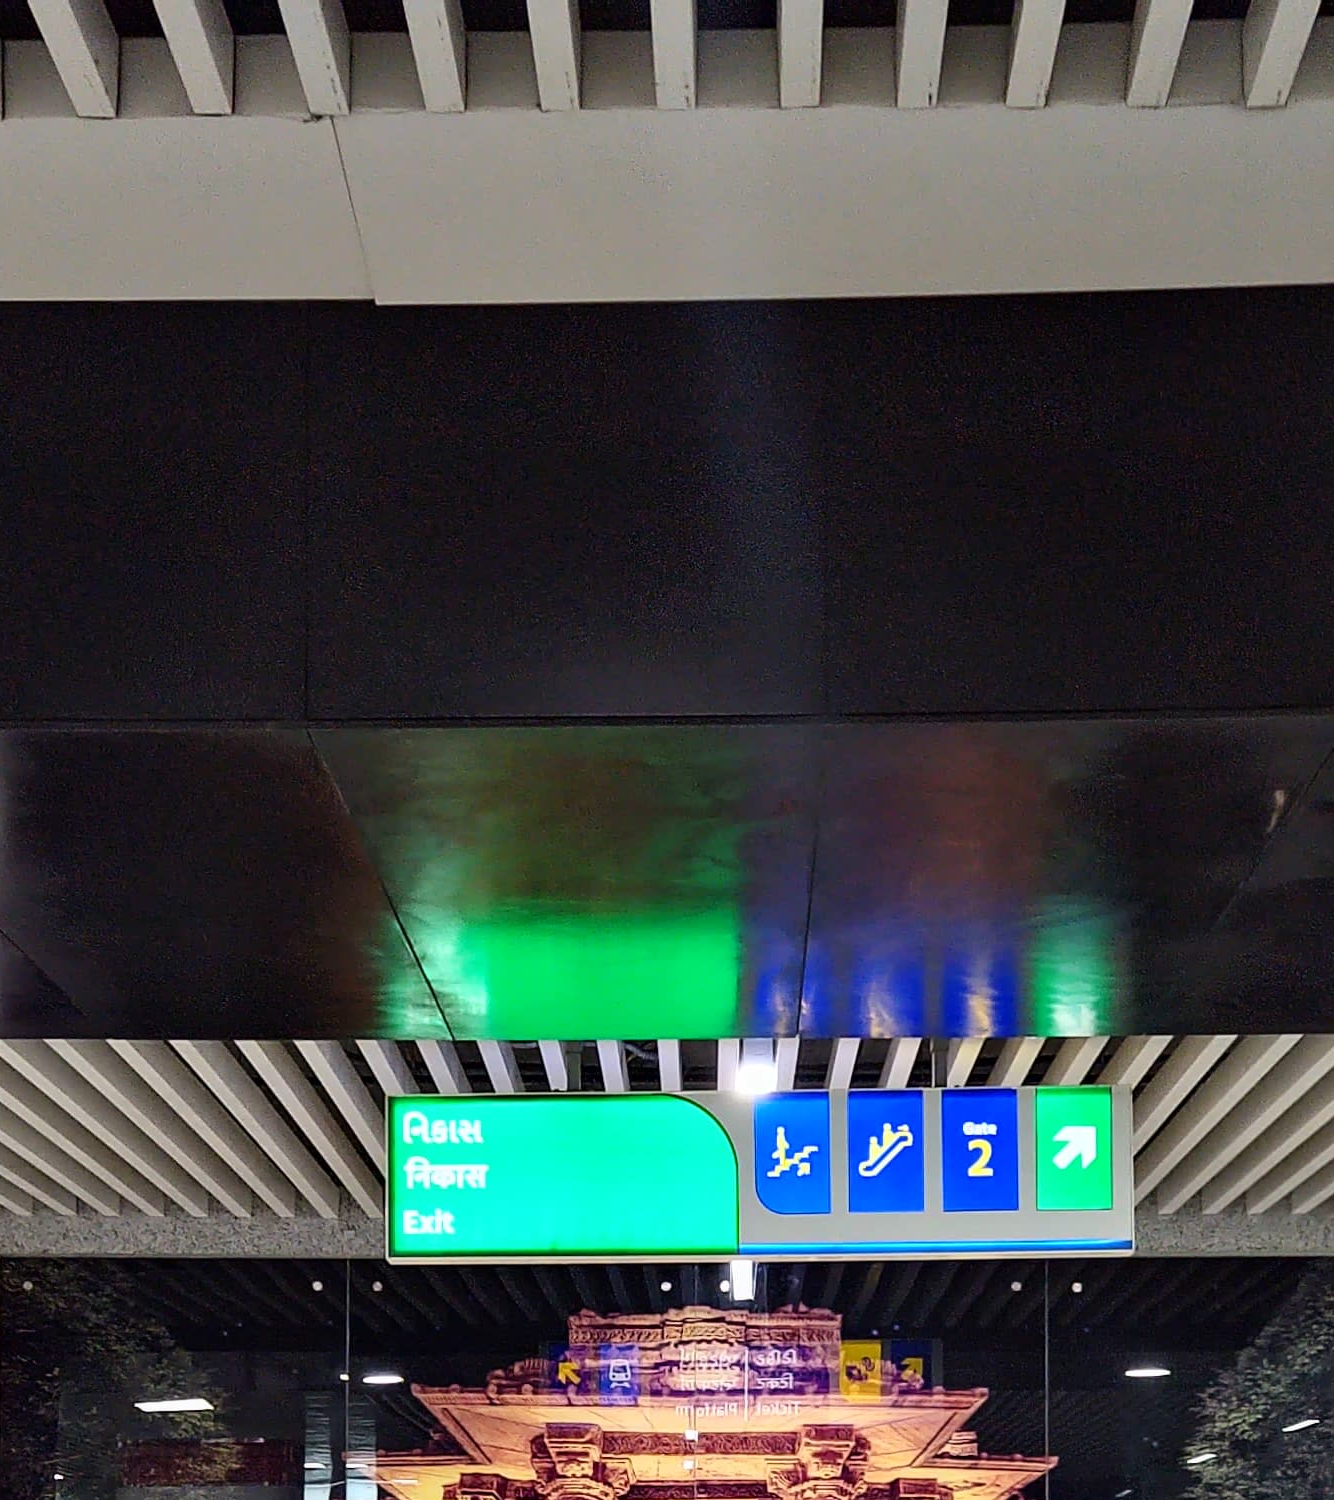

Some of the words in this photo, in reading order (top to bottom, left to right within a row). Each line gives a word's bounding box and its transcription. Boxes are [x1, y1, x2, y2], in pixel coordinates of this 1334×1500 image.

[403, 1111, 484, 1144] નિકાસ
[403, 1155, 490, 1189] निकास
[967, 1139, 994, 1177] 2
[403, 1208, 455, 1235] Exit
